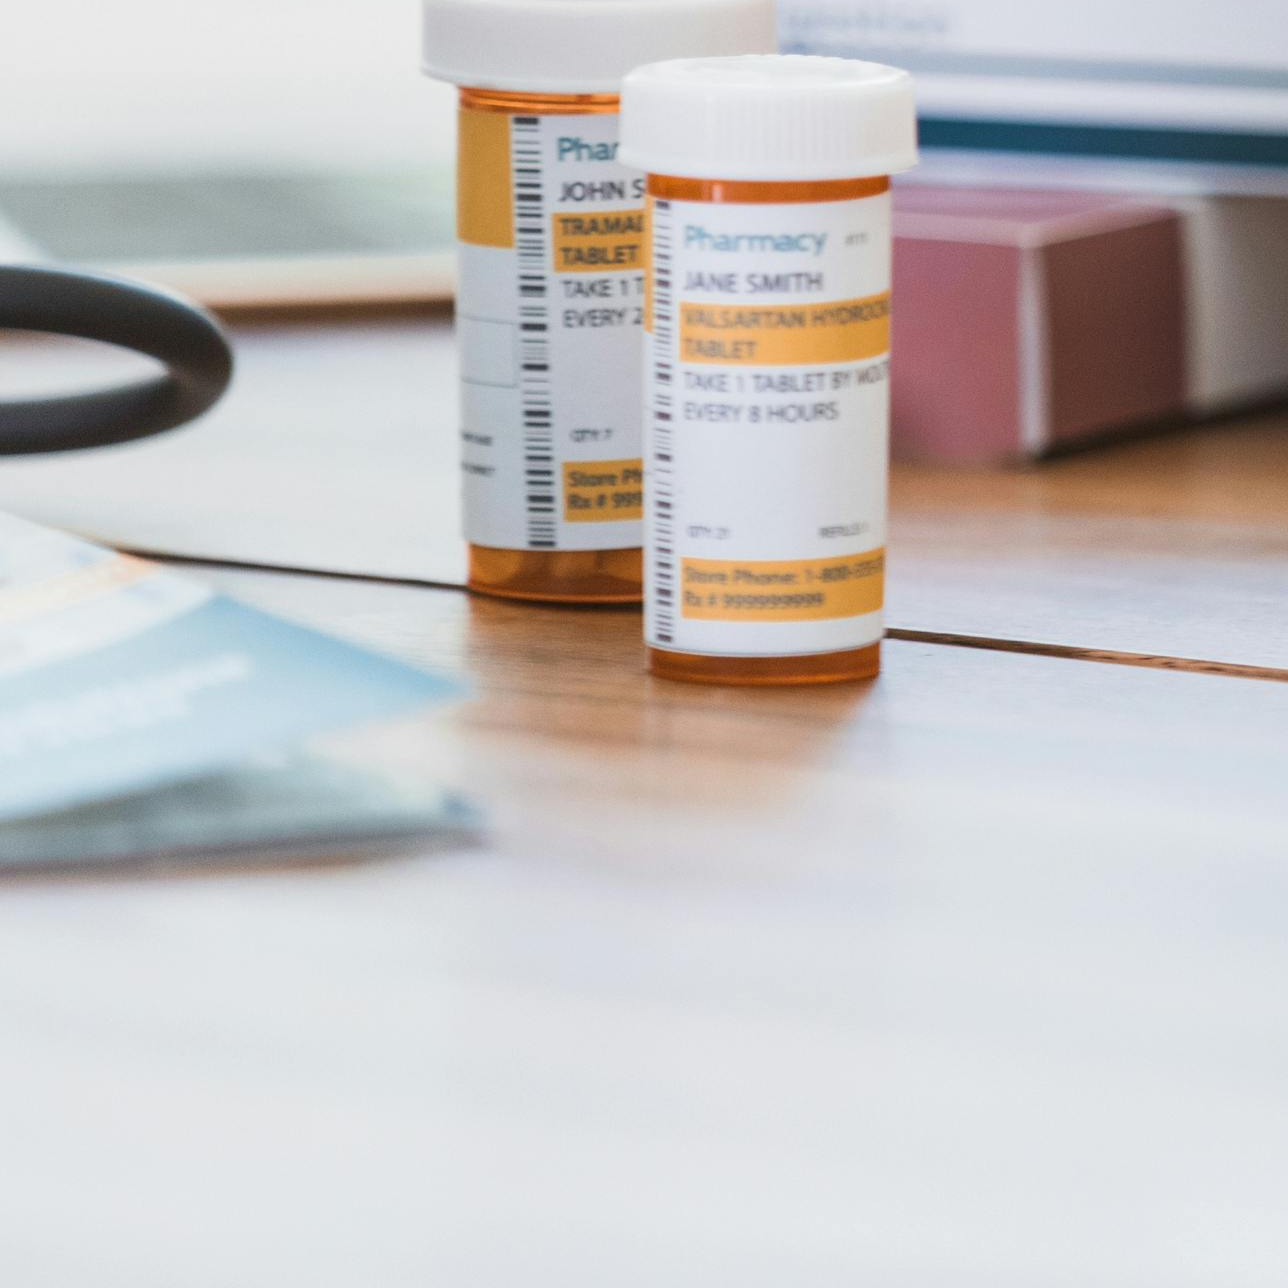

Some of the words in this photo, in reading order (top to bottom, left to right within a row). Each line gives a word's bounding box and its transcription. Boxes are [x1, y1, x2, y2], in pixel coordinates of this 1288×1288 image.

[556, 136, 619, 162] Phar
[559, 179, 625, 203] JOHN
[632, 178, 645, 199] S
[683, 224, 829, 256] Pharmacy
[560, 244, 640, 265] TABLET
[561, 278, 613, 299] TAKE
[683, 271, 740, 293] JANE
[746, 271, 824, 294] SMITH
[562, 308, 627, 329] EVERY
[682, 337, 758, 360] TABLET
[683, 370, 730, 393] TAKE
[752, 371, 825, 393] TABLET
[683, 400, 745, 423] EVERY
[766, 399, 839, 424] HOURS
